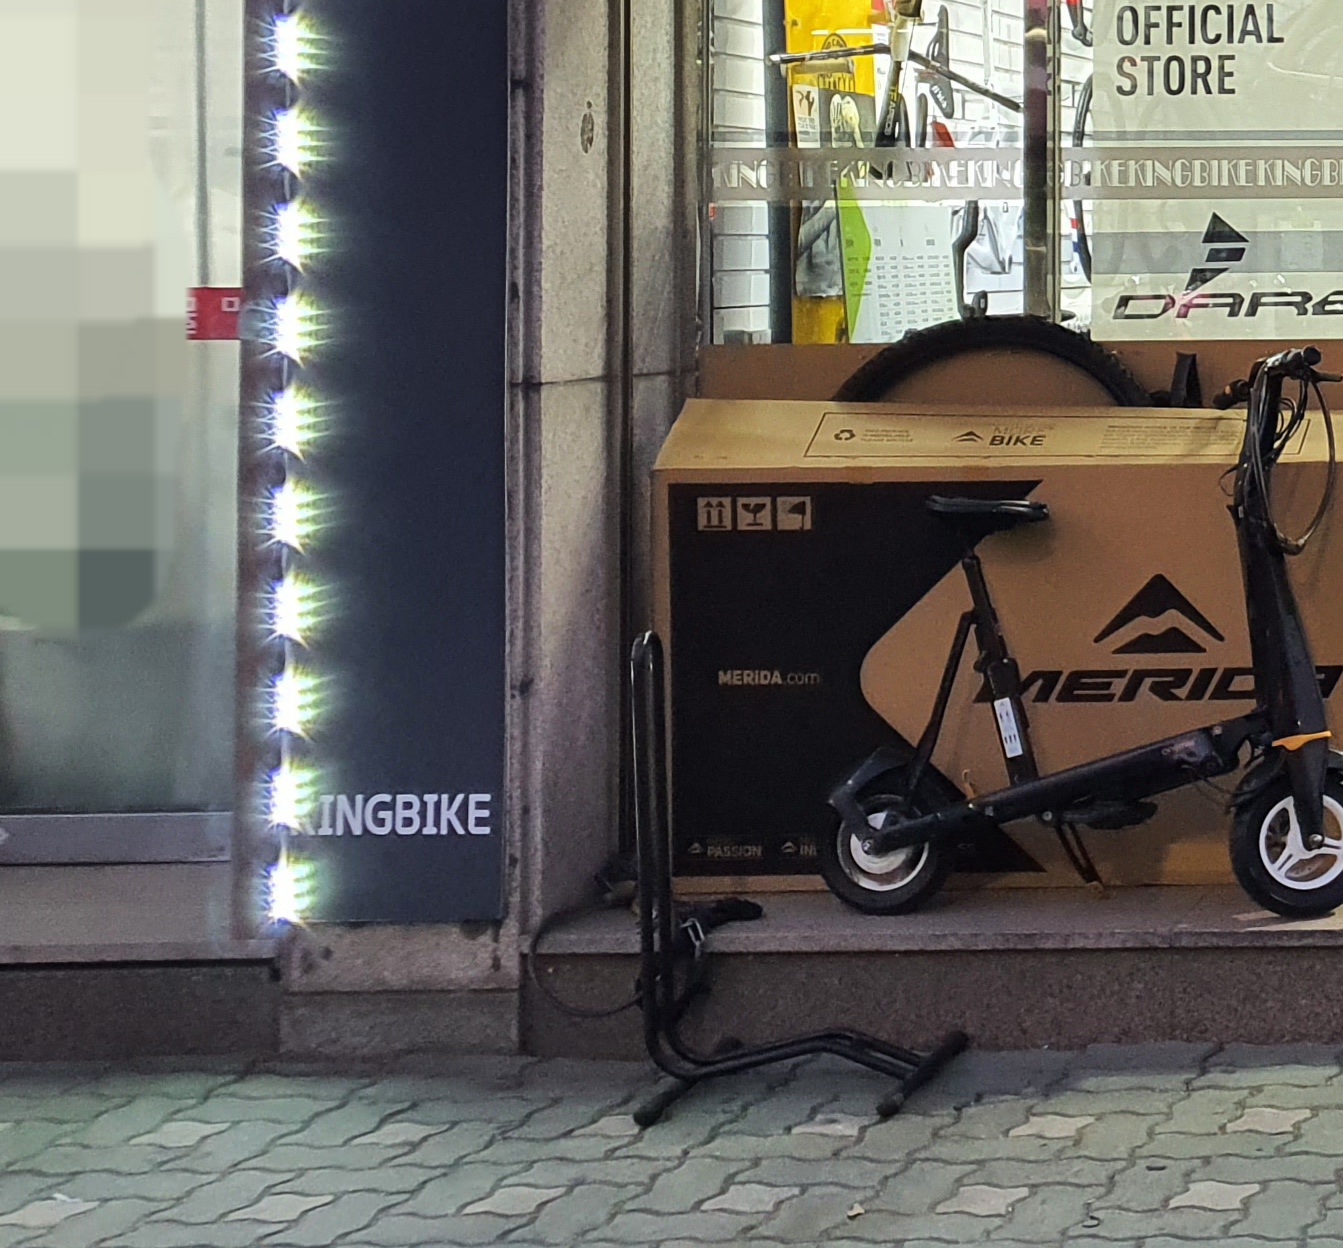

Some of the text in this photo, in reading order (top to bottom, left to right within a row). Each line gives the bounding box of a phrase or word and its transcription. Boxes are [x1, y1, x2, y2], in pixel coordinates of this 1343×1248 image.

[1116, 4, 1285, 45] OFFICIAL
[1116, 54, 1238, 97] STORE
[989, 435, 1047, 446] BIKE
